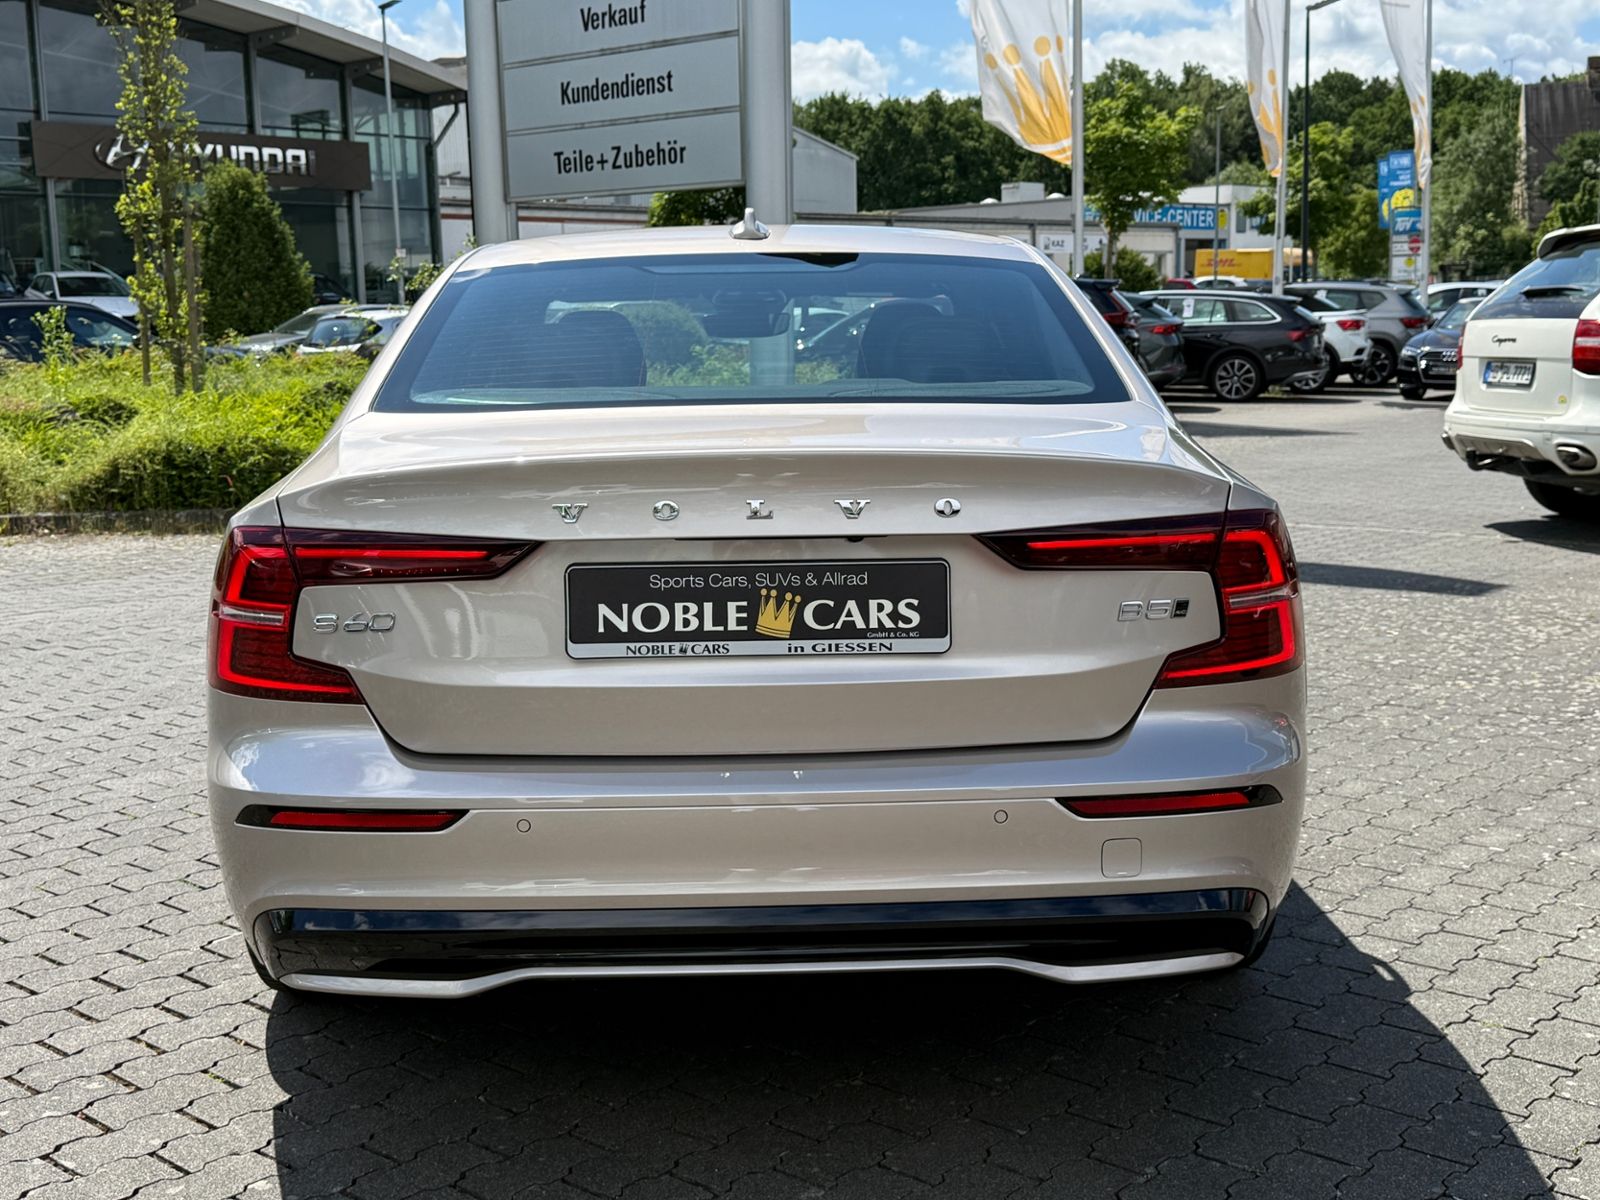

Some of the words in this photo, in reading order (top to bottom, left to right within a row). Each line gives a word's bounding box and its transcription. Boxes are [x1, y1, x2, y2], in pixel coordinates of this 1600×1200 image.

[580, 0, 646, 32] Verkauf
[560, 70, 673, 106] Kundendienst
[553, 139, 687, 175] Teile+Zubehör
[552, 497, 962, 524] VOLVO
[650, 573, 705, 591] Sports
[709, 573, 751, 590] Cars,
[755, 571, 801, 587] SUVs
[805, 572, 818, 586] &
[823, 570, 868, 586] Allrad
[597, 601, 748, 633] NOBLE
[803, 598, 920, 631] CARS
[1118, 600, 1171, 621] B5
[625, 644, 677, 656] NOBLE
[690, 643, 731, 655] CARS
[786, 642, 809, 654] in
[811, 641, 893, 653] GIESSEN
